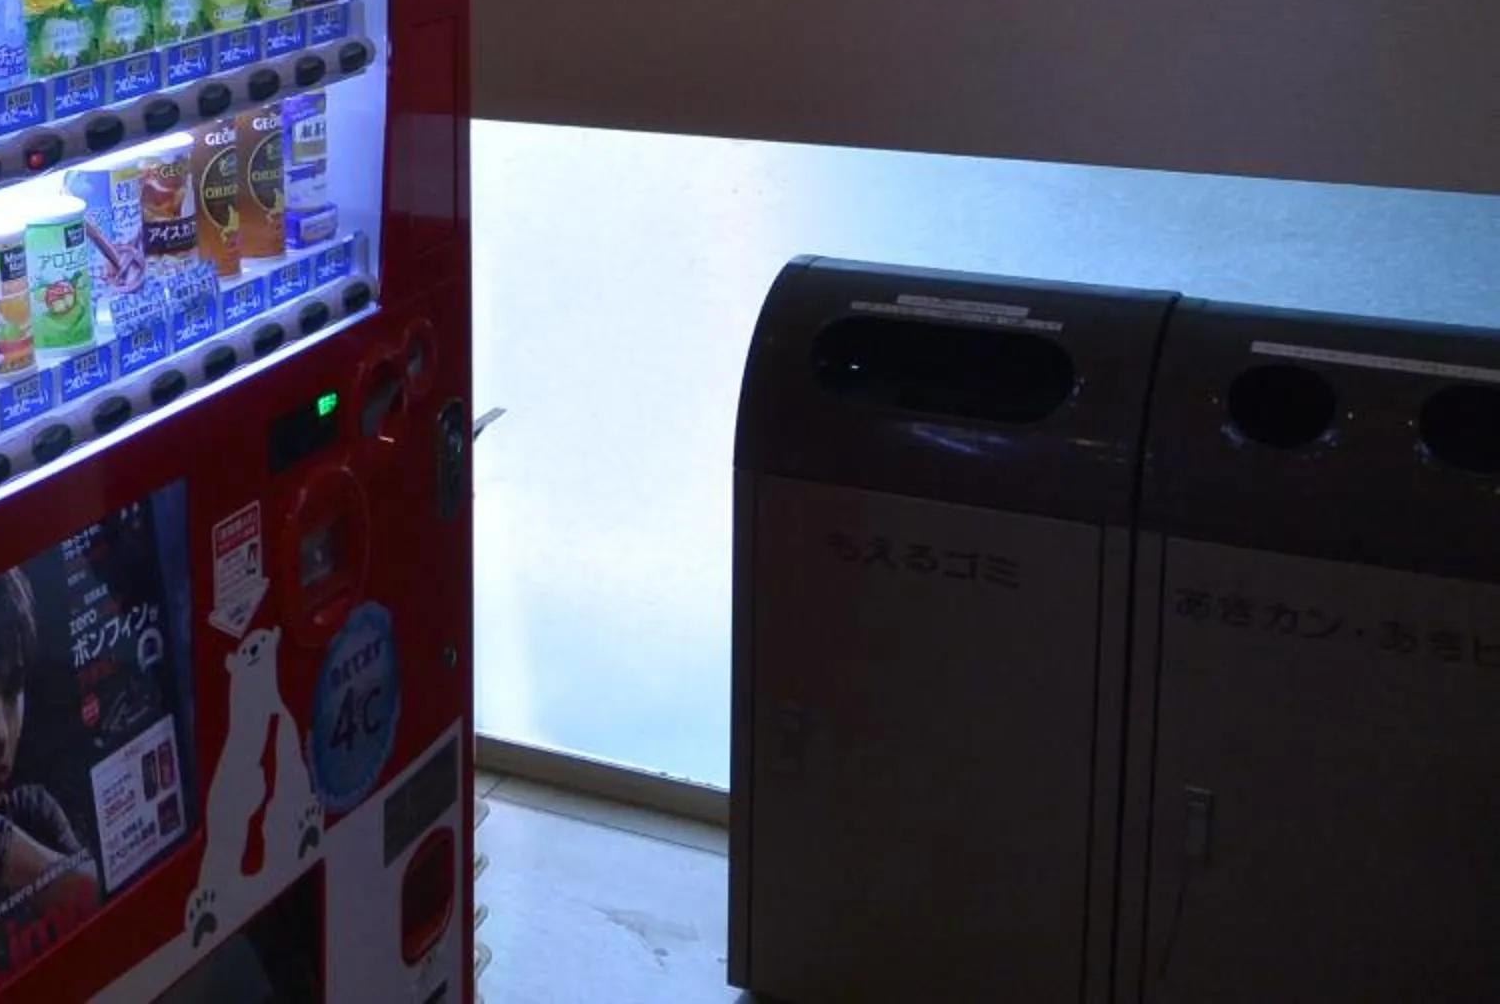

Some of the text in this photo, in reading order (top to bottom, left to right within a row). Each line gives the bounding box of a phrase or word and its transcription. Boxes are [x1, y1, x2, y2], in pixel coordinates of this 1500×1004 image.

[825, 530, 1020, 590] もえるゴミ
